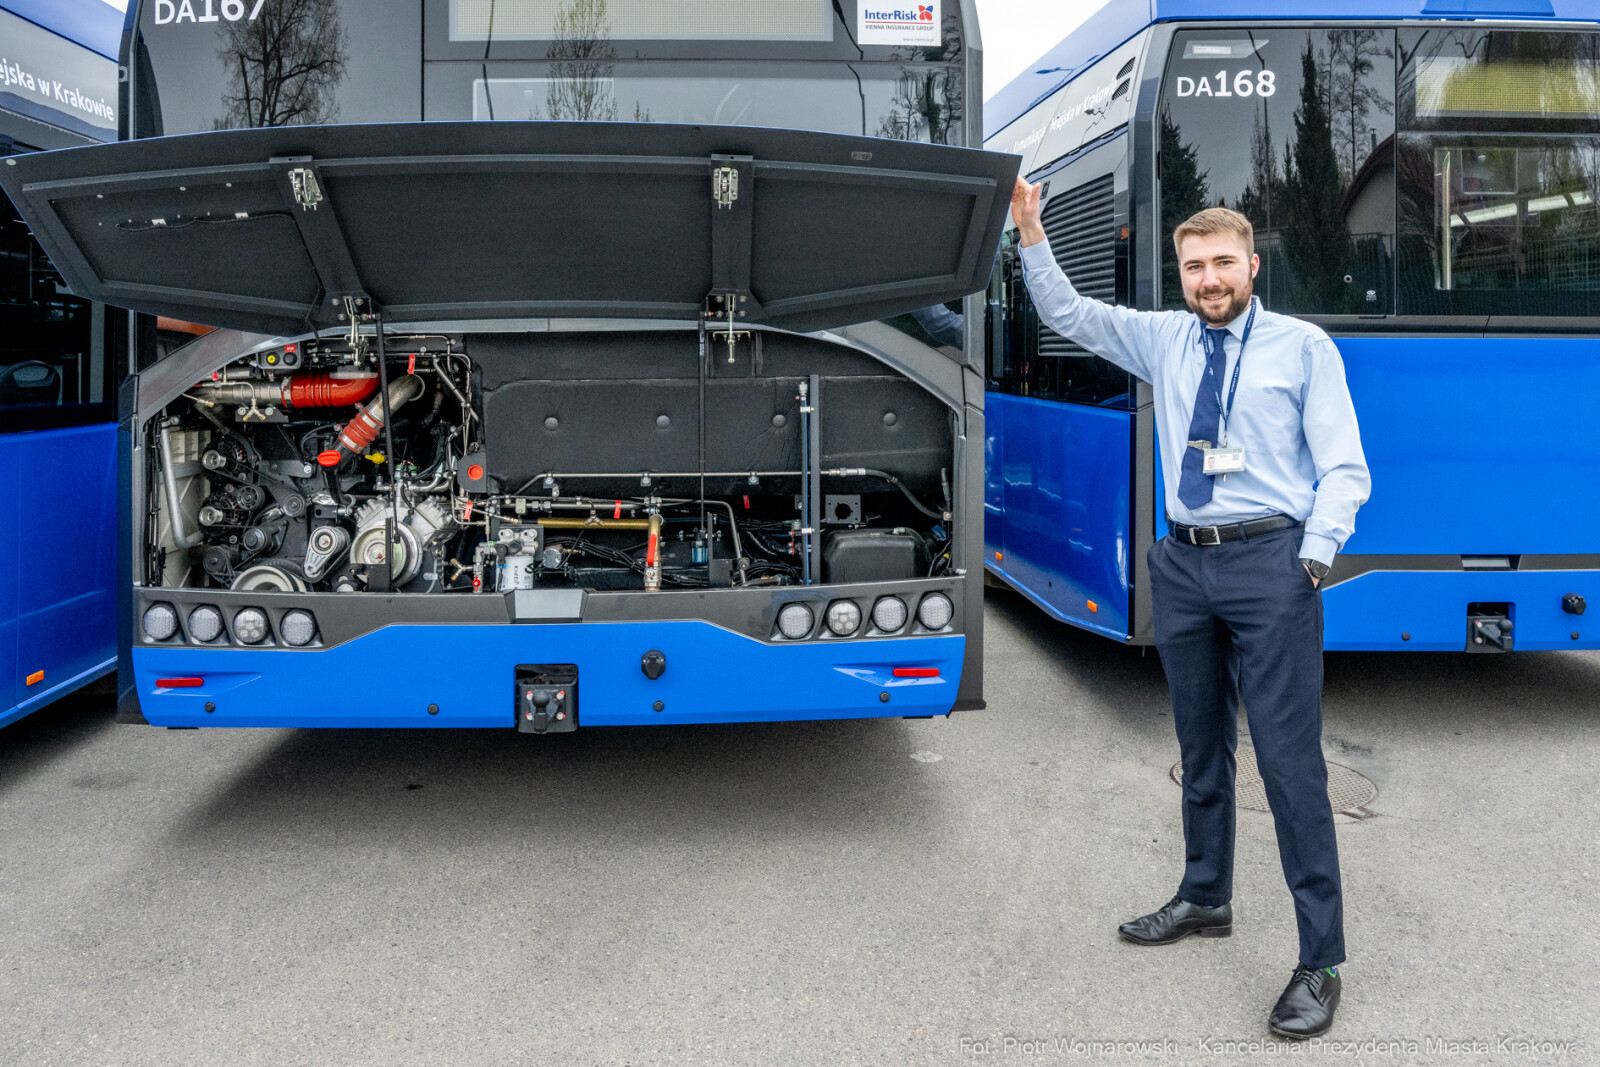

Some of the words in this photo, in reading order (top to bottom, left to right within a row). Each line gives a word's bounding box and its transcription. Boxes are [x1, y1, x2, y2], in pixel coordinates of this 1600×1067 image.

[865, 9, 917, 21] InterRisk
[1177, 69, 1276, 97] DA168
[37, 78, 50, 97] w
[53, 80, 115, 121] Krakowie
